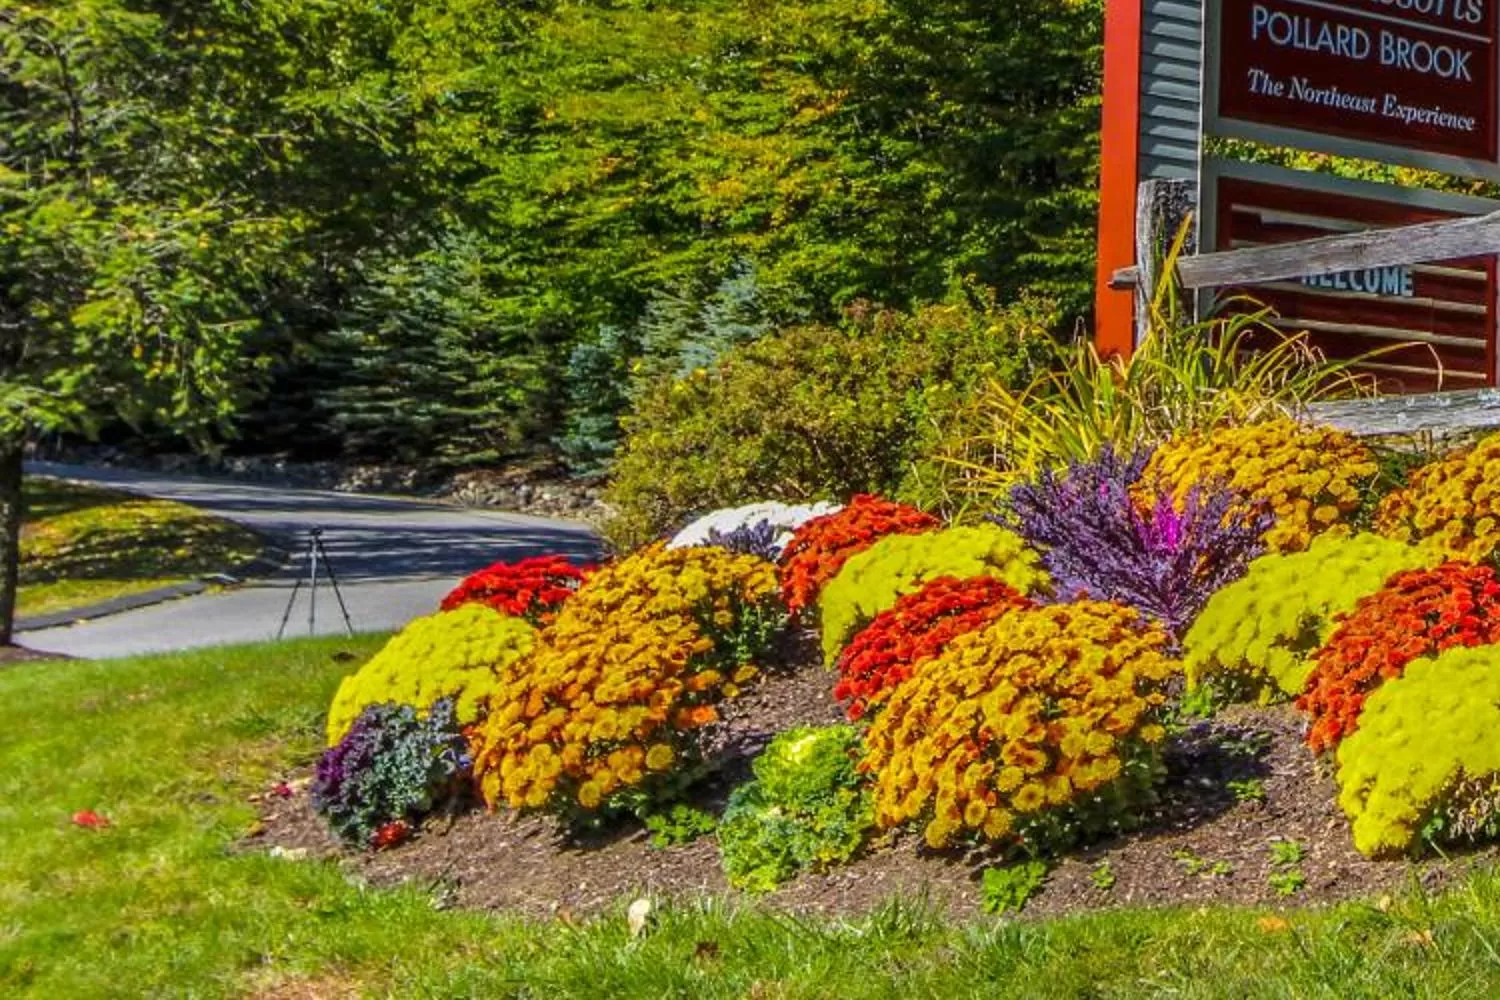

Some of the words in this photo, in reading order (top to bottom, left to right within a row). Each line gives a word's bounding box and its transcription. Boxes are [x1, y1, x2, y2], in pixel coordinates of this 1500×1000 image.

[1251, 4, 1371, 59] POLLARD
[1380, 30, 1473, 82] BROOK
[1248, 67, 1285, 97] The
[1288, 75, 1377, 113] Northeast
[1382, 93, 1475, 131] Experience
